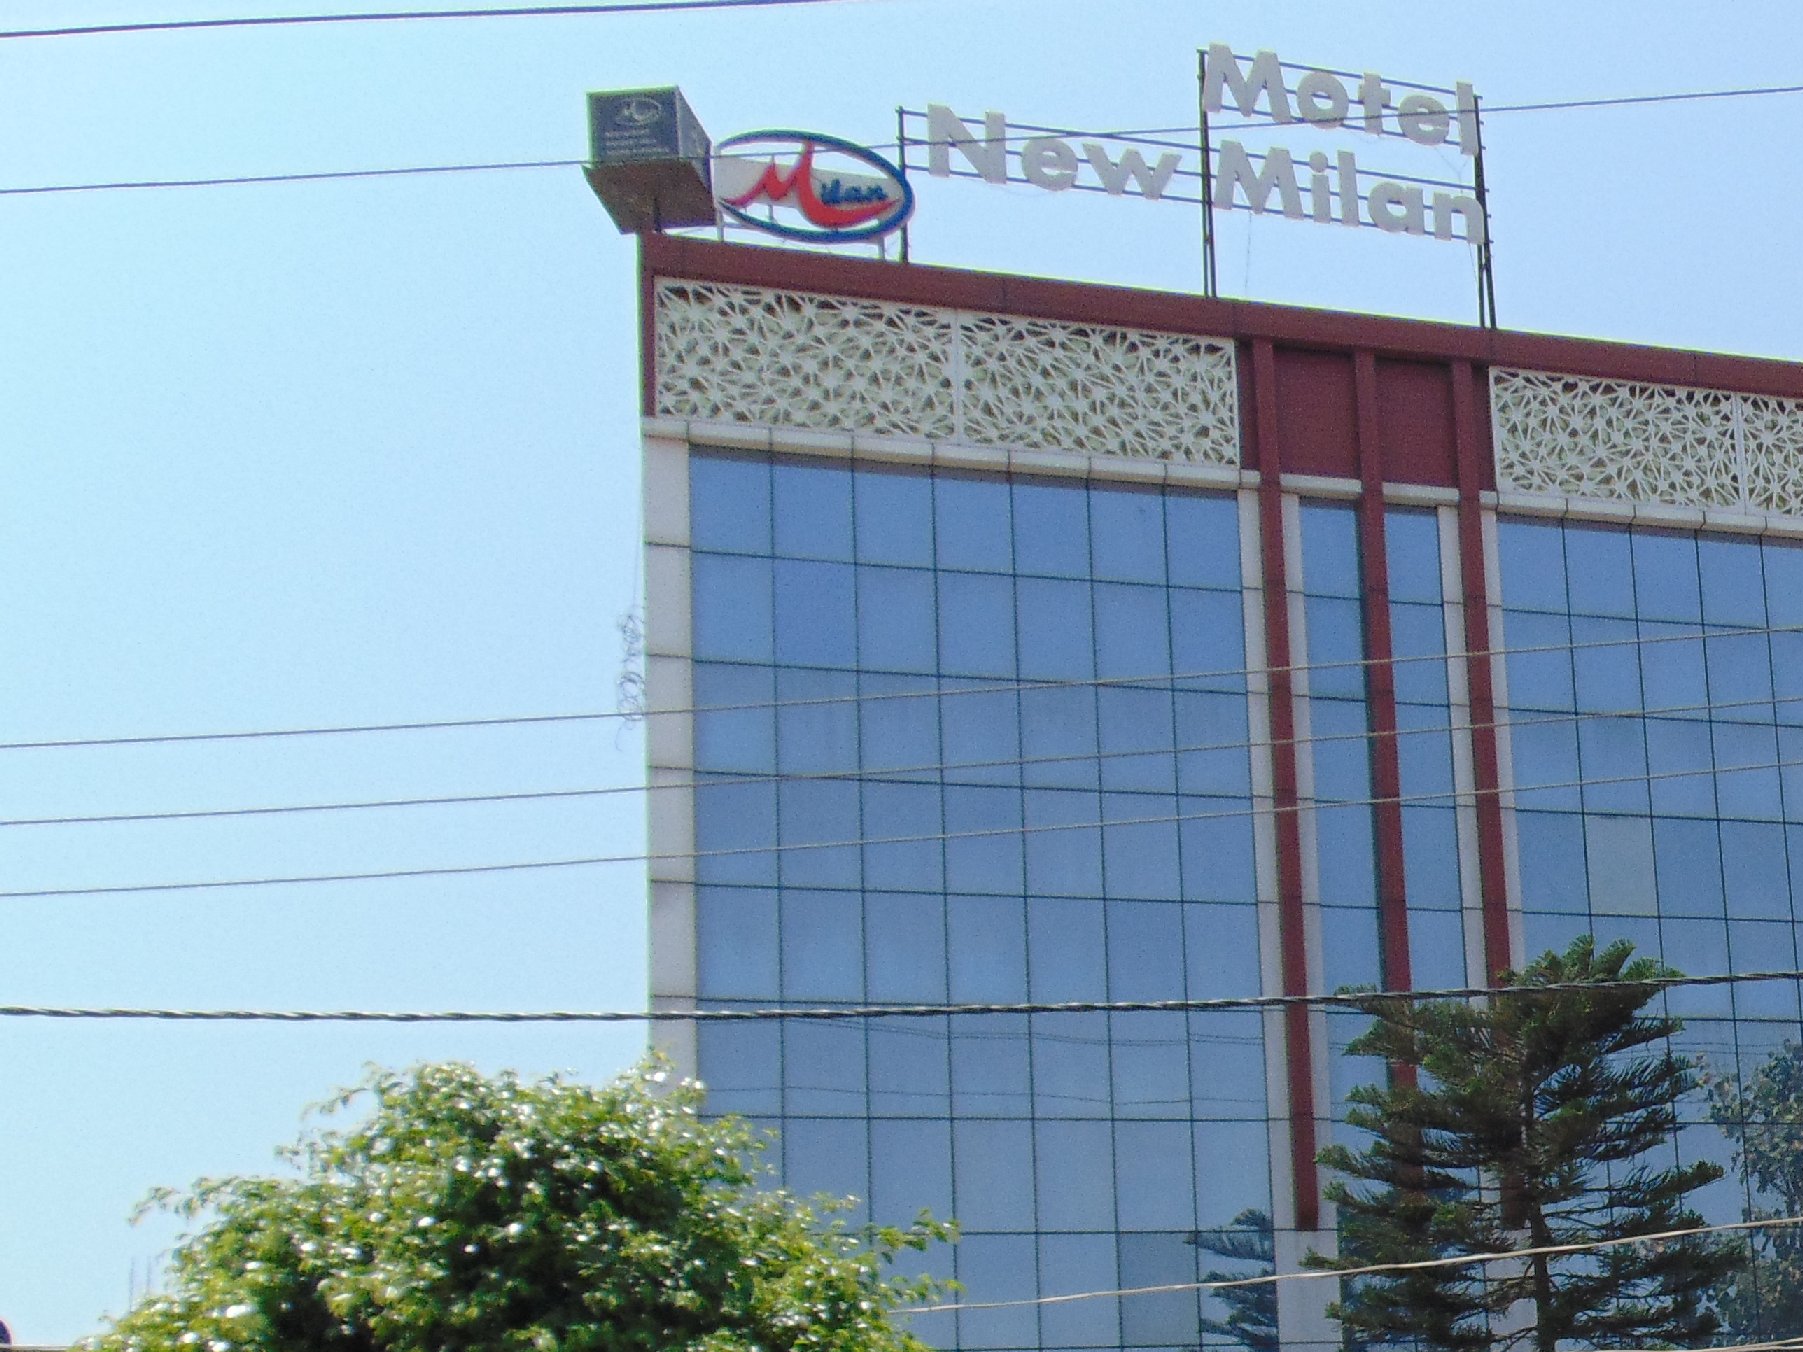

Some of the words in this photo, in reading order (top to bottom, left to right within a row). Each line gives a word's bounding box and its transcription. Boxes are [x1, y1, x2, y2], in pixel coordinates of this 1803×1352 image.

[1202, 43, 1479, 156] Motel
[926, 102, 1183, 201] New
[1212, 138, 1485, 245] Milan
